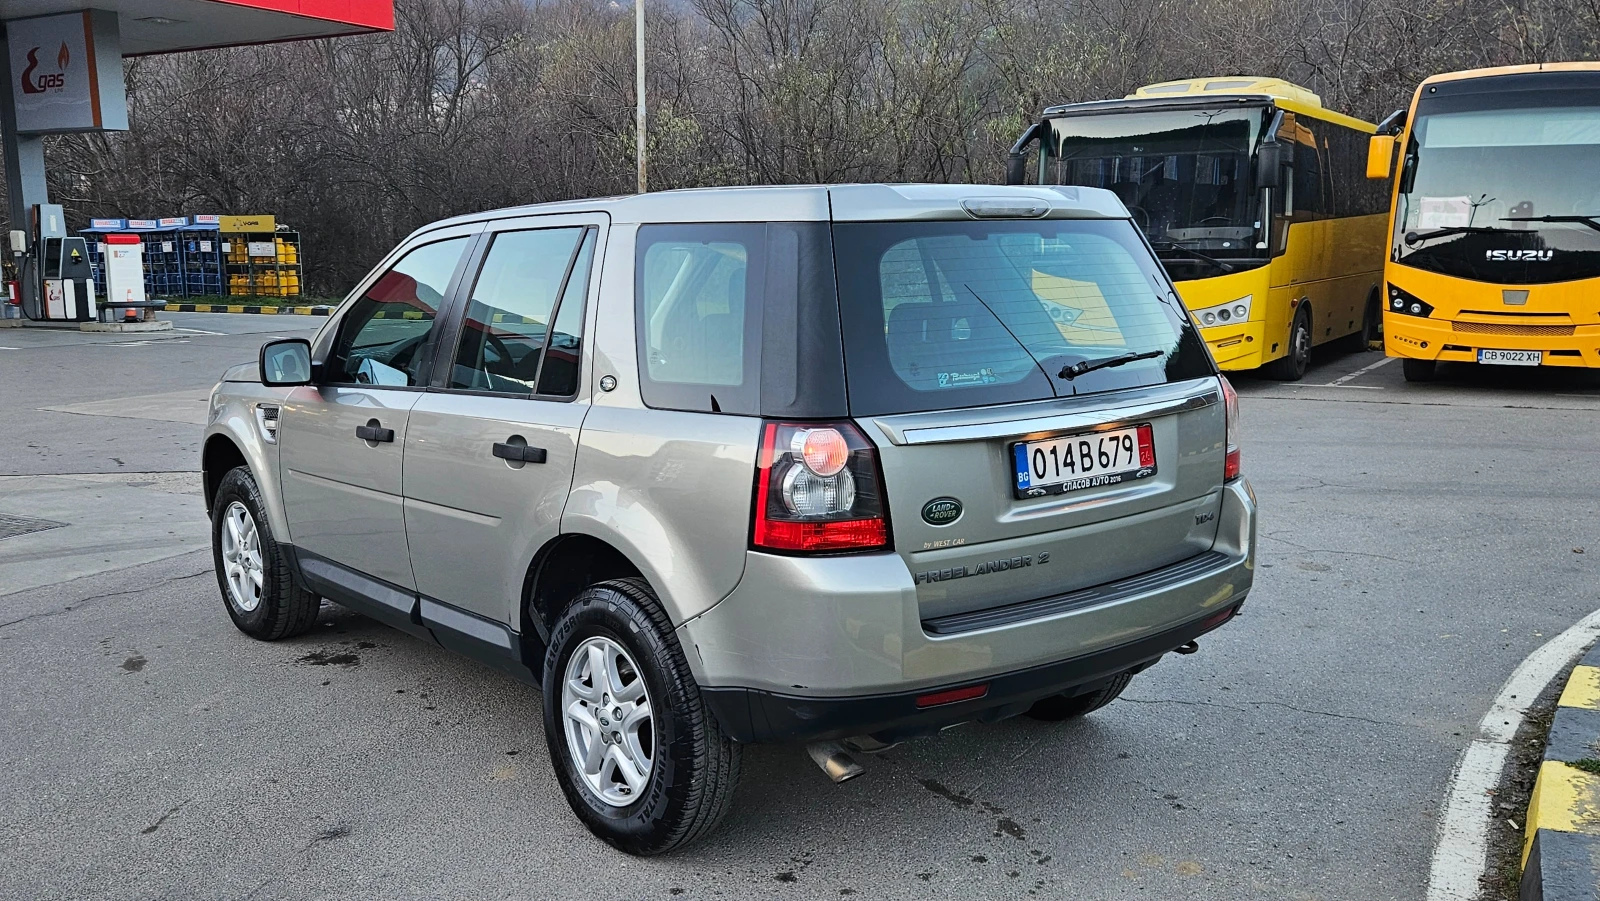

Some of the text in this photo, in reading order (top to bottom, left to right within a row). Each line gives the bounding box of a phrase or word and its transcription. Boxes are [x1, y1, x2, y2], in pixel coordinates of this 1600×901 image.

[1486, 250, 1553, 261] ISUZU
[1484, 351, 1540, 362] CB 9022 XH
[1017, 471, 1029, 482] BG
[1062, 475, 1122, 492] СПАСОВ АУТО 2016
[932, 504, 951, 513] LAND
[934, 509, 957, 519] ROVER
[923, 538, 965, 549] by WEST CAR
[914, 551, 1050, 586] FREELANDER 2
